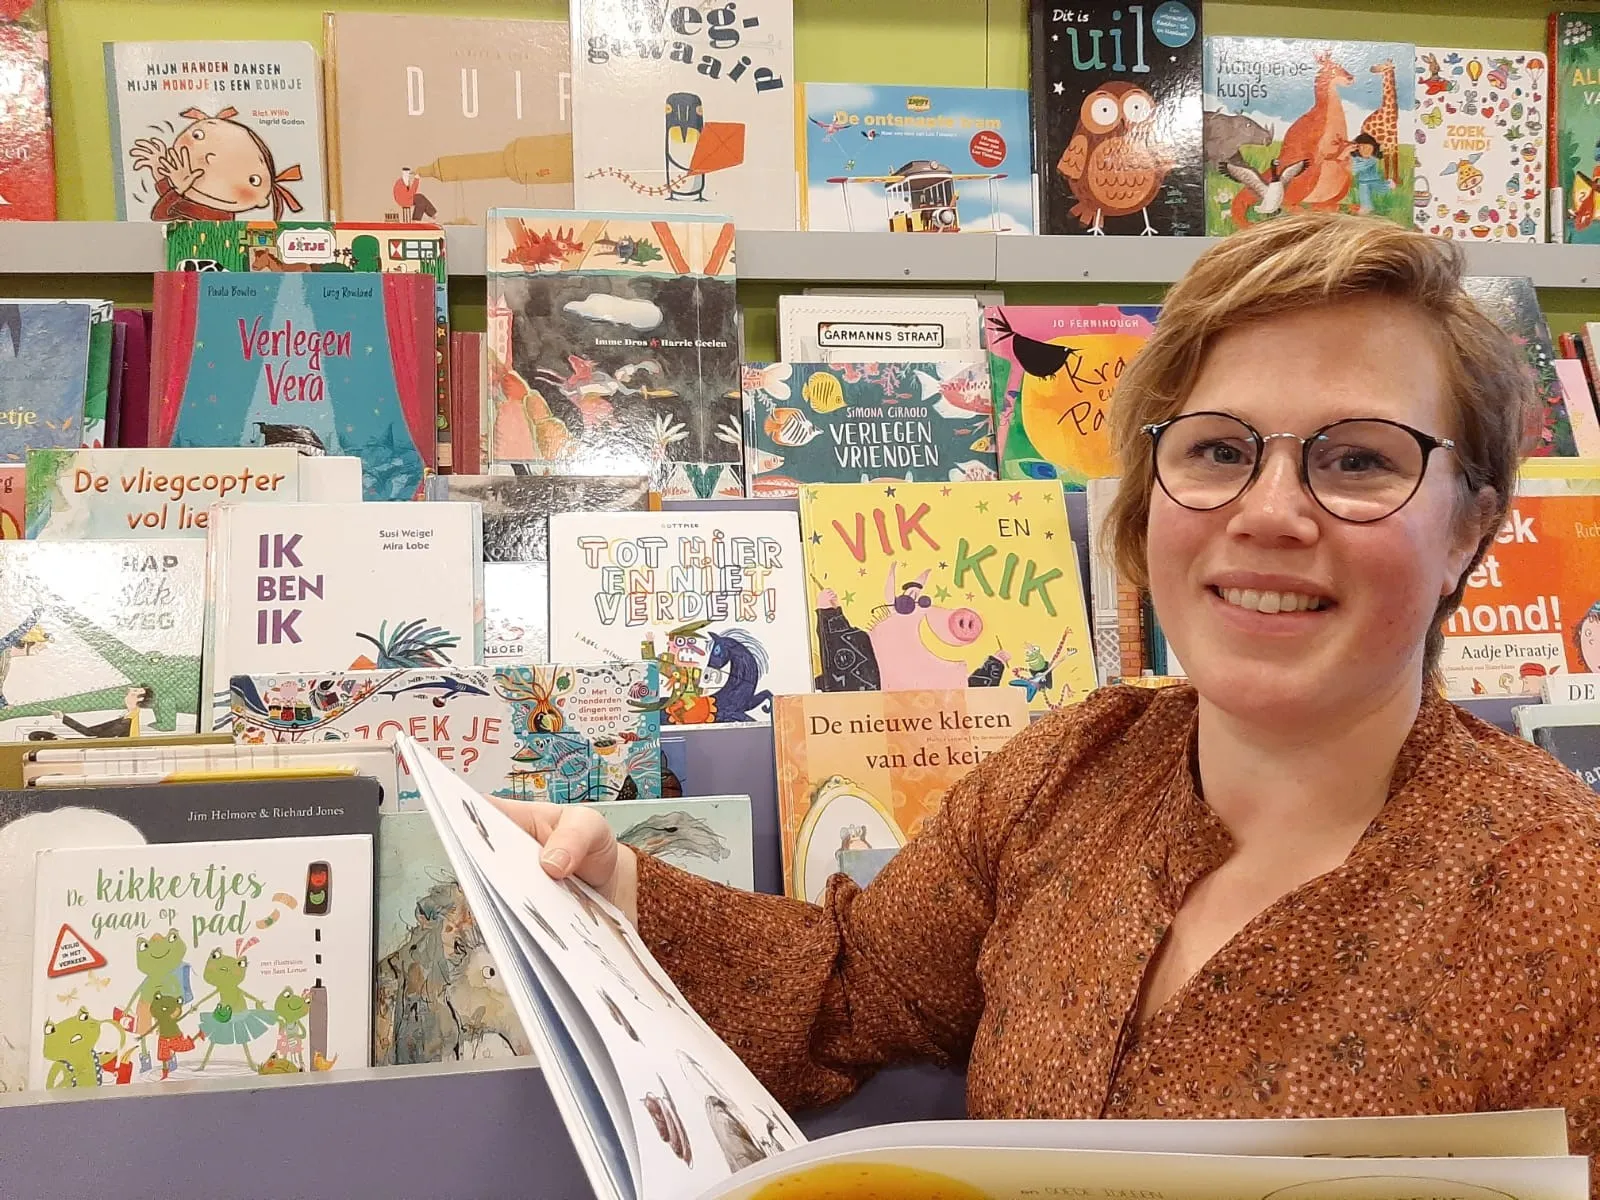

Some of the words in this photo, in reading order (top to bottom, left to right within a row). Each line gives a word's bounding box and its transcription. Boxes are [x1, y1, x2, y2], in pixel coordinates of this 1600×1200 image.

[1053, 9, 1074, 22] Dit
[1077, 10, 1089, 22] is
[1066, 5, 1150, 72] uil
[147, 63, 177, 75] MIJN
[181, 61, 229, 73] HANDEN
[234, 63, 281, 75] DANSEN
[1571, 68, 1600, 87] AL
[127, 79, 158, 92] MIJN
[162, 79, 210, 91] MONDJE
[214, 79, 225, 92] IS
[230, 79, 251, 91] EEN
[256, 79, 302, 90] RONDJE
[1216, 76, 1268, 106] kusjes
[259, 118, 280, 126] Ingrid
[834, 110, 859, 125] De
[960, 116, 1001, 129] tram
[1447, 125, 1486, 137] ZOEK
[1052, 319, 1065, 328] JO
[1070, 319, 1139, 328] FERNIHOUGH
[237, 315, 352, 371] Verlegen
[624, 338, 648, 346] Dros
[824, 329, 892, 342] GARMANNS
[897, 330, 939, 342] STRAAT
[264, 360, 325, 406] Vera
[829, 421, 932, 445] VERLEGEN
[834, 445, 939, 468] VRIENDEN
[74, 467, 109, 493] De
[120, 466, 286, 501] vliegcopter
[127, 503, 168, 530] vol
[998, 518, 1031, 537] EN
[379, 529, 400, 539] Susi
[401, 529, 434, 539] Weigel
[831, 502, 940, 563] VIK
[258, 533, 304, 568] IK
[383, 542, 404, 551] Mira
[406, 542, 430, 550] Lobe
[577, 535, 667, 569] TOT
[257, 574, 324, 602] BEN
[602, 566, 654, 594] EN
[953, 537, 1063, 618] KIK
[594, 588, 777, 627] VERDER!
[257, 608, 303, 645] IK
[1461, 643, 1501, 661] Aadje
[1504, 642, 1559, 661] Piraatje
[578, 697, 622, 705] honderden
[591, 688, 607, 696] Met
[1568, 683, 1595, 702] DE
[578, 707, 607, 715] dingen
[462, 716, 502, 745] JE
[809, 715, 843, 736] De
[849, 714, 934, 734] nieuwe
[939, 710, 1012, 730] kleren
[865, 752, 907, 769] van
[913, 747, 940, 767] de
[187, 810, 208, 822] Jim
[211, 809, 256, 821] Helmore
[259, 808, 270, 819] &
[273, 807, 313, 819] Richard
[315, 805, 344, 817] Jones
[67, 888, 88, 907] De
[96, 863, 266, 911] kikkertjes
[91, 908, 150, 940] gaan
[159, 907, 177, 926] op
[191, 900, 251, 949] pad
